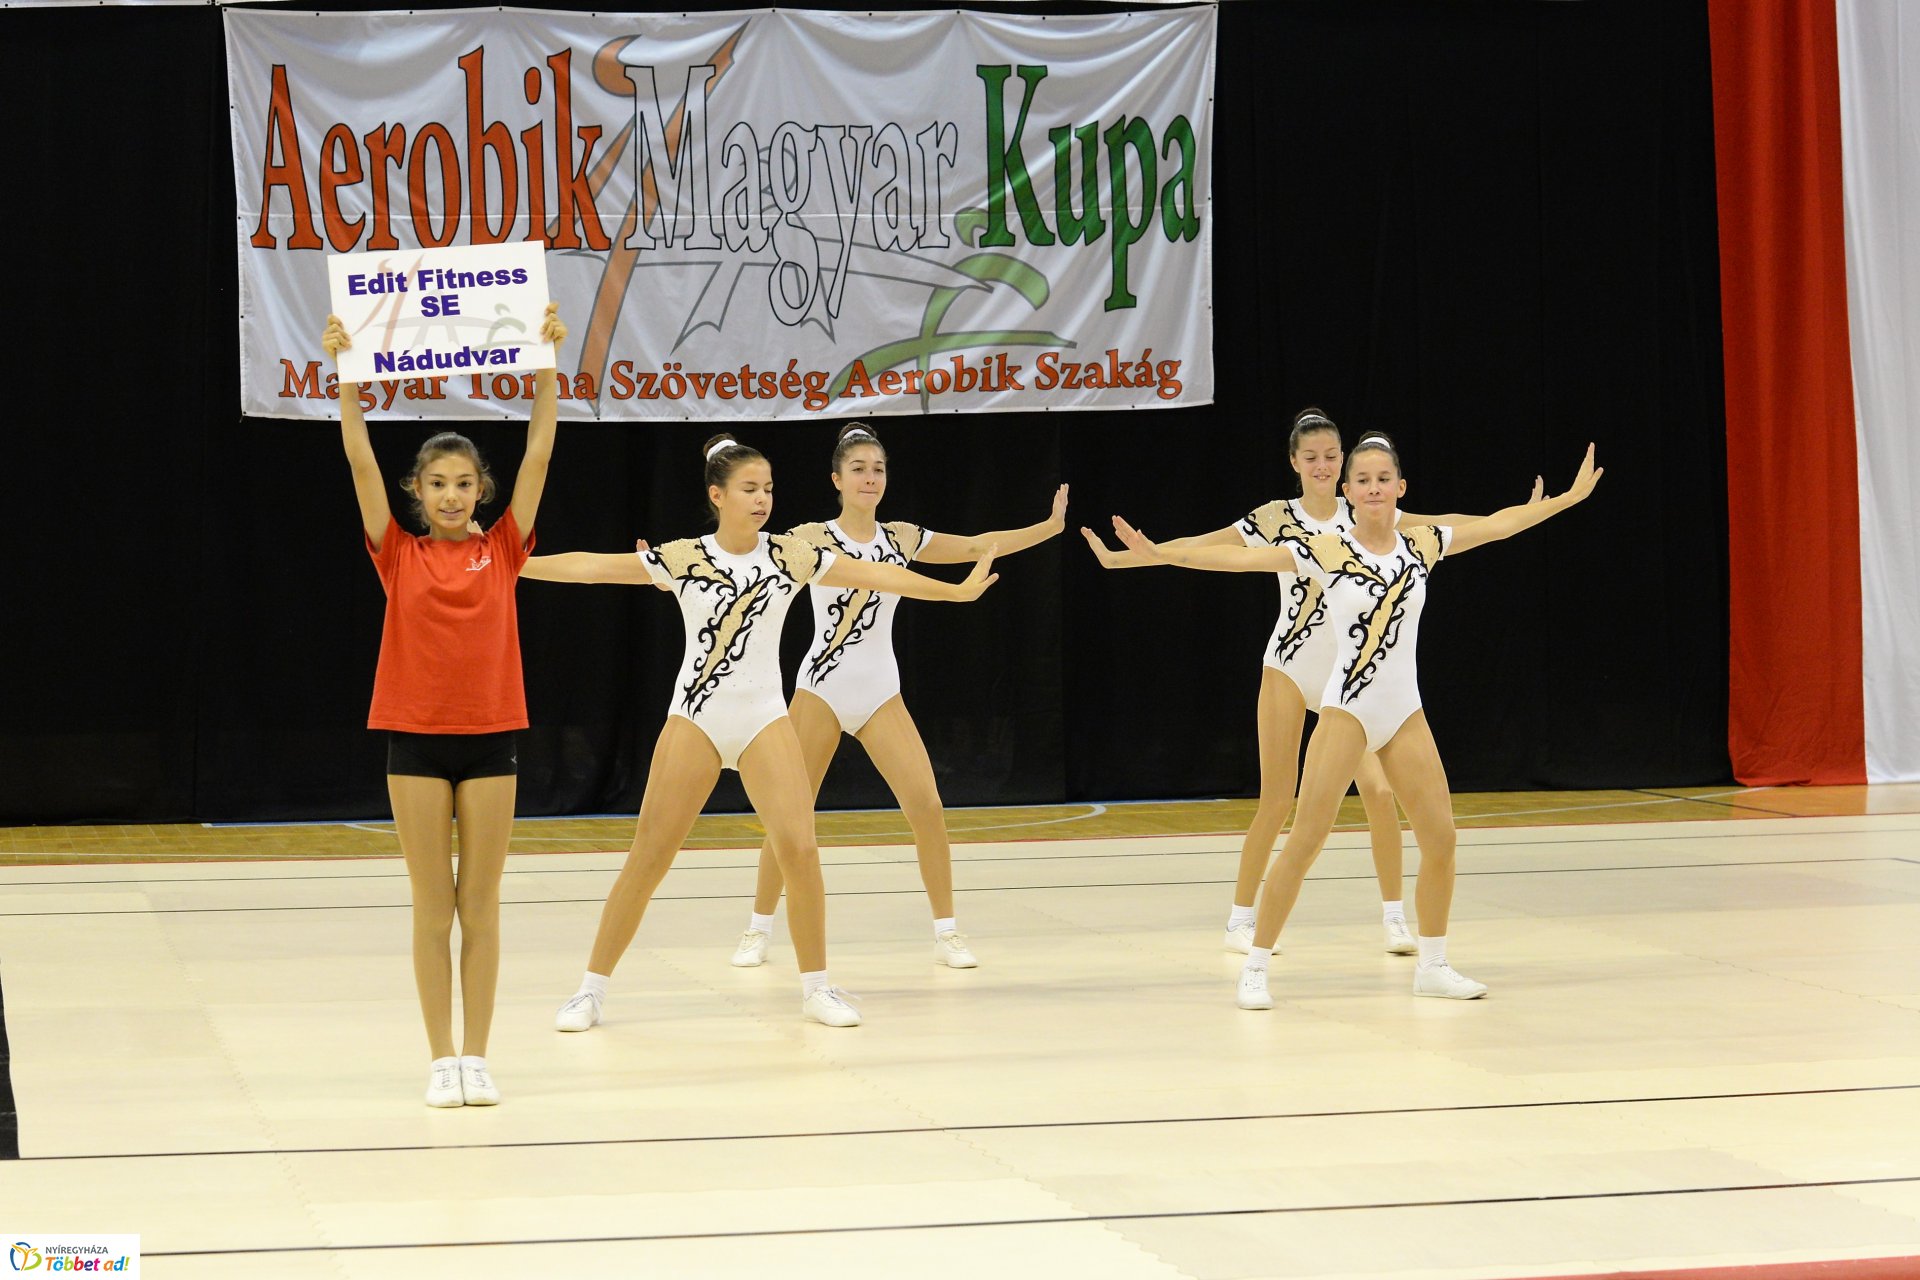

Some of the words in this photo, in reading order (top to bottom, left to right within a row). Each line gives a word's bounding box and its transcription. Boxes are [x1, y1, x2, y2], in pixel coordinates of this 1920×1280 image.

[250, 45, 612, 253] Aerobik
[624, 64, 958, 326] Magyar
[976, 64, 1201, 312] Kupa
[348, 271, 408, 296] Edit
[417, 267, 528, 291] Fitness
[420, 294, 461, 318] SE
[374, 345, 520, 374] Nádudvar
[609, 358, 830, 412] Szövetség
[838, 352, 1025, 398] Aerobik
[1034, 347, 1183, 400] Szakág
